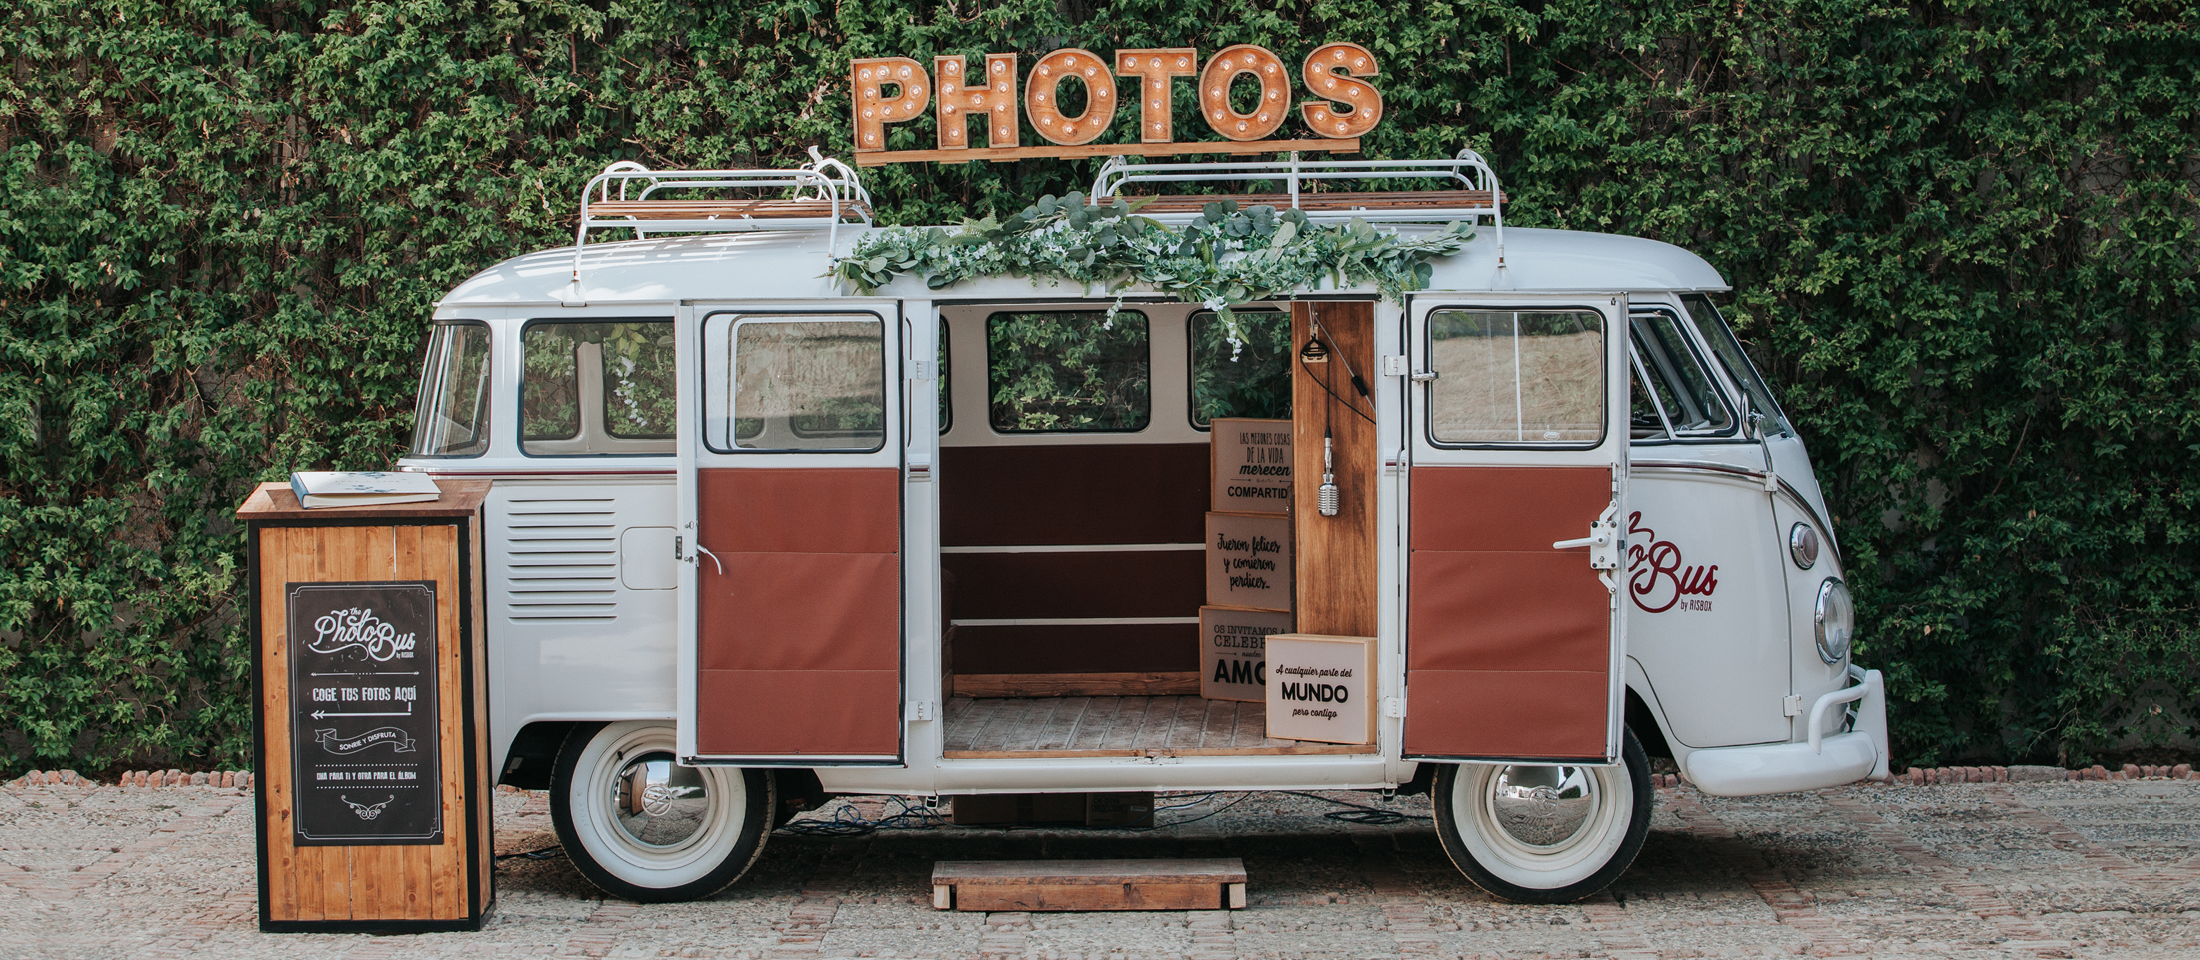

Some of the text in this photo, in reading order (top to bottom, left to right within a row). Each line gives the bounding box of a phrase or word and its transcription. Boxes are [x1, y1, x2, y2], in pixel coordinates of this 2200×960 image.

[850, 42, 1383, 152] PHOTOS
[1239, 432, 1291, 446] LAS MEJORES COSAS
[1246, 446, 1284, 464] DE LA VIDA
[1238, 464, 1291, 477] merecen
[1217, 533, 1281, 557] Fueron felices
[1223, 555, 1276, 574] y comieron
[1629, 541, 1719, 614] Bus
[349, 607, 362, 616] the
[1680, 599, 1713, 612] by RISBOX
[1213, 624, 1225, 634] OS
[1227, 625, 1278, 635] INVITAMOS
[1275, 664, 1353, 678] A cualquier parte del
[312, 685, 417, 702] COGE TUS FOTOS AQUÍ
[1281, 681, 1349, 703] MUNDO
[1292, 708, 1338, 720] pero contigo
[367, 731, 397, 743] DISFRUTA
[328, 772, 344, 780] PARA
[351, 772, 357, 780] Y
[357, 771, 372, 780] OTRA
[373, 771, 389, 780] PARA
[389, 771, 396, 780] EL
